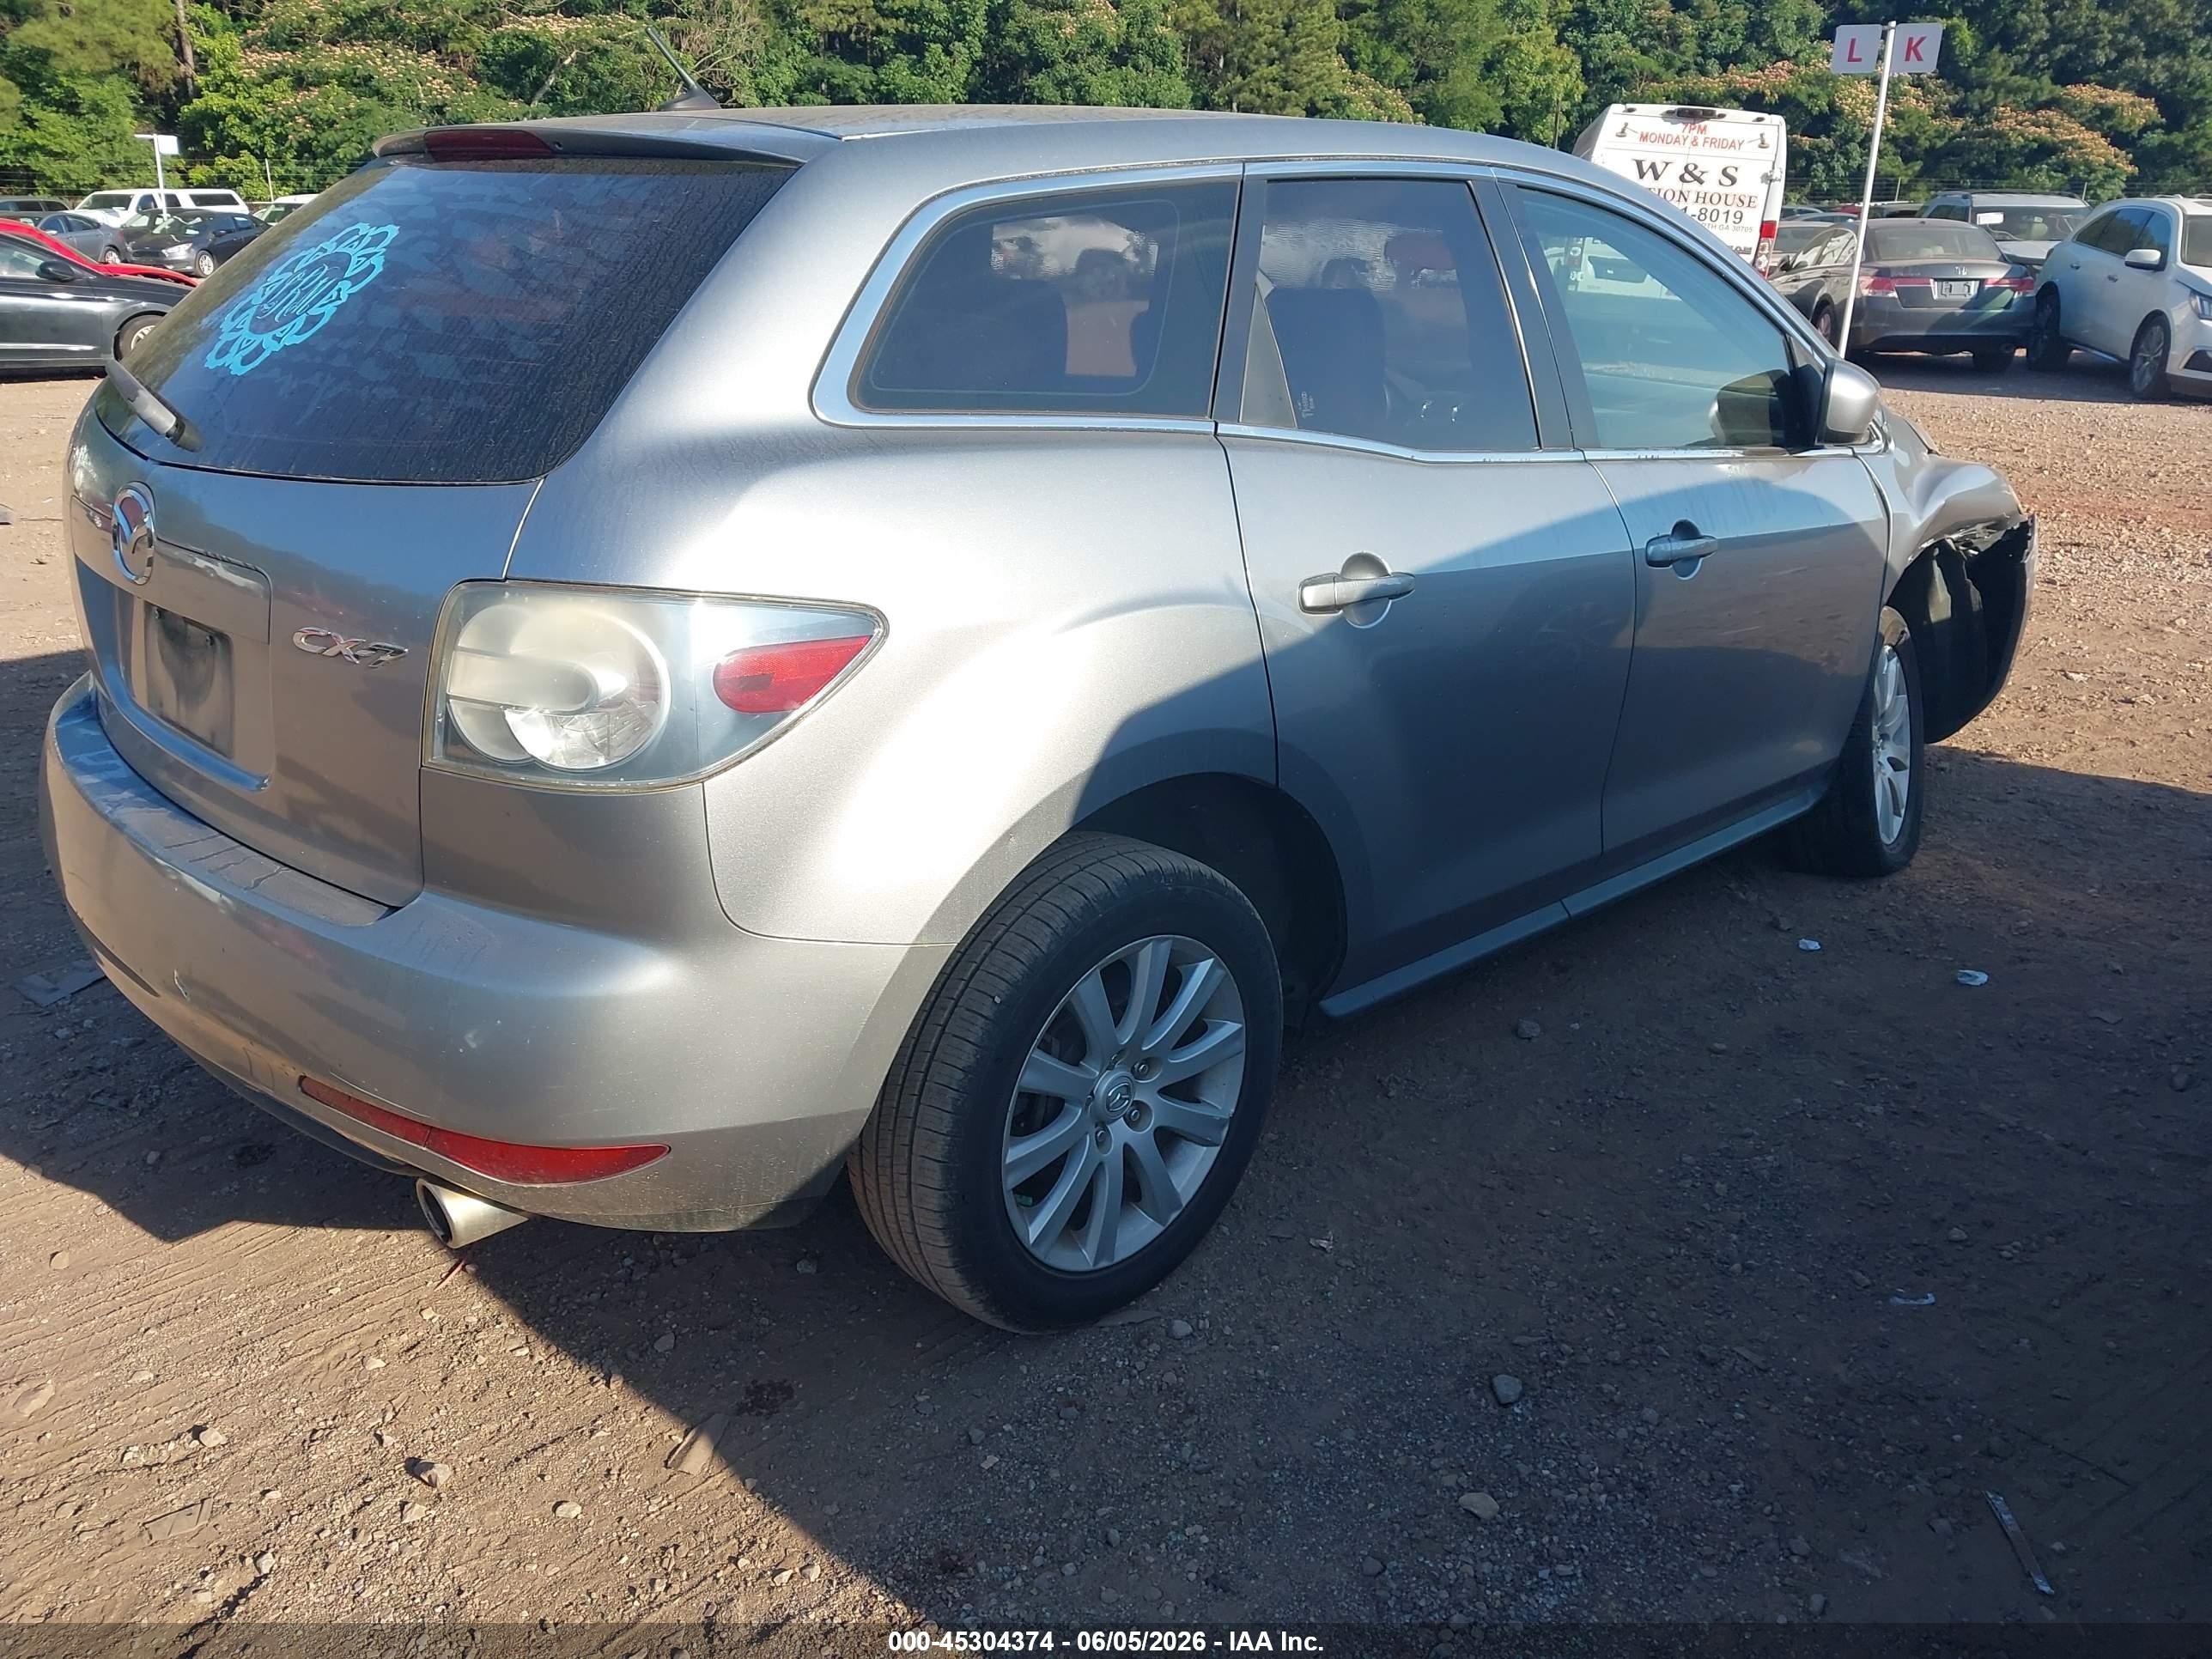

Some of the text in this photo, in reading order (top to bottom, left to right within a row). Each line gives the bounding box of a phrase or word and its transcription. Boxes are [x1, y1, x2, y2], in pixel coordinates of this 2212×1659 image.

[1847, 38, 1863, 63] L
[1905, 36, 1927, 62] K
[1638, 131, 1745, 150] MONDAY & FRIDAY
[1680, 123, 1708, 135] 7PM
[1632, 158, 1739, 187] W & S
[1694, 191, 1759, 209] HOUSE
[292, 625, 410, 669] CX-7
